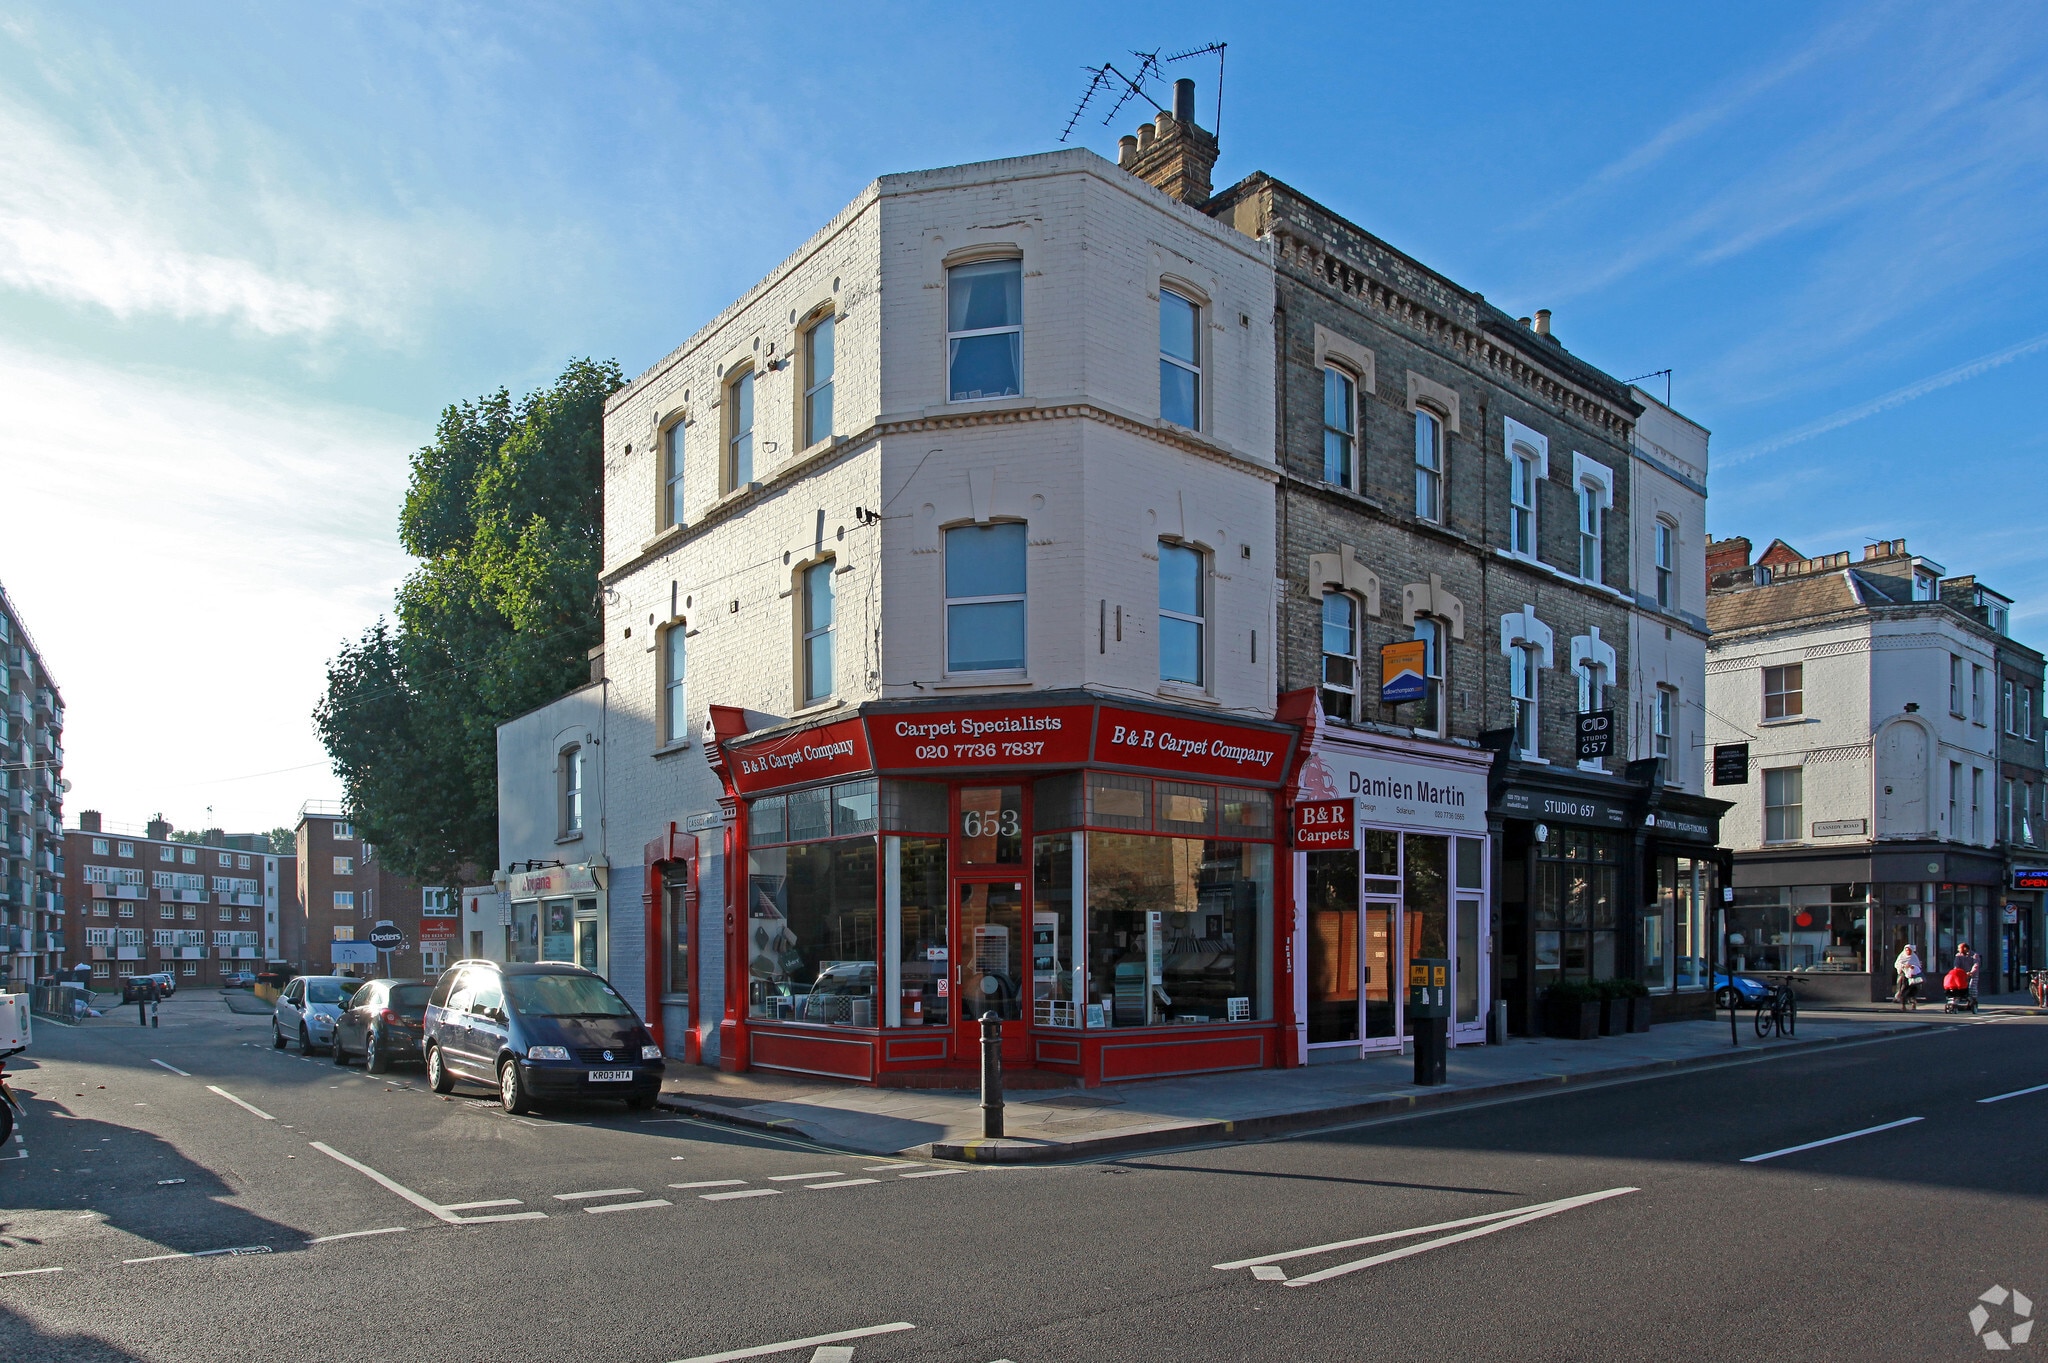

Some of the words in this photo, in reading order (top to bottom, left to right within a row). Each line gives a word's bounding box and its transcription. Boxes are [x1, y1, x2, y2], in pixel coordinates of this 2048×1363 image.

[895, 720, 957, 740] Carpet
[961, 715, 1062, 738] Specialists
[1582, 734, 1608, 742] STUDIO
[915, 745, 949, 760] 020
[953, 743, 997, 758] 7736
[1001, 741, 1044, 757] 7837
[1111, 725, 1126, 745] B
[1126, 730, 1139, 747] &
[1141, 730, 1155, 749] R
[1158, 732, 1208, 758] Carpet
[1211, 740, 1274, 768] Company
[1582, 742, 1607, 754] 657
[741, 760, 751, 775] B
[751, 760, 759, 773] &
[758, 756, 768, 771] R
[768, 748, 804, 769] Carpet
[803, 739, 854, 761] Company
[1349, 771, 1413, 801] Damien
[1417, 780, 1465, 807] Martin
[1360, 801, 1377, 812] Design
[1544, 800, 1577, 815] STUDIO
[1580, 805, 1595, 817] 657
[1302, 807, 1315, 825] B
[1317, 806, 1328, 824] &
[1331, 805, 1345, 824] R
[1434, 810, 1443, 819] 020
[964, 810, 1019, 838] 653
[1297, 827, 1350, 844] Carpets
[2020, 879, 2048, 887] OPEN
[371, 933, 400, 942] Dexters
[1415, 966, 1424, 974] PAY
[1412, 976, 1426, 984] HERE
[592, 1071, 614, 1080] KR03
[615, 1071, 630, 1079] HTA
